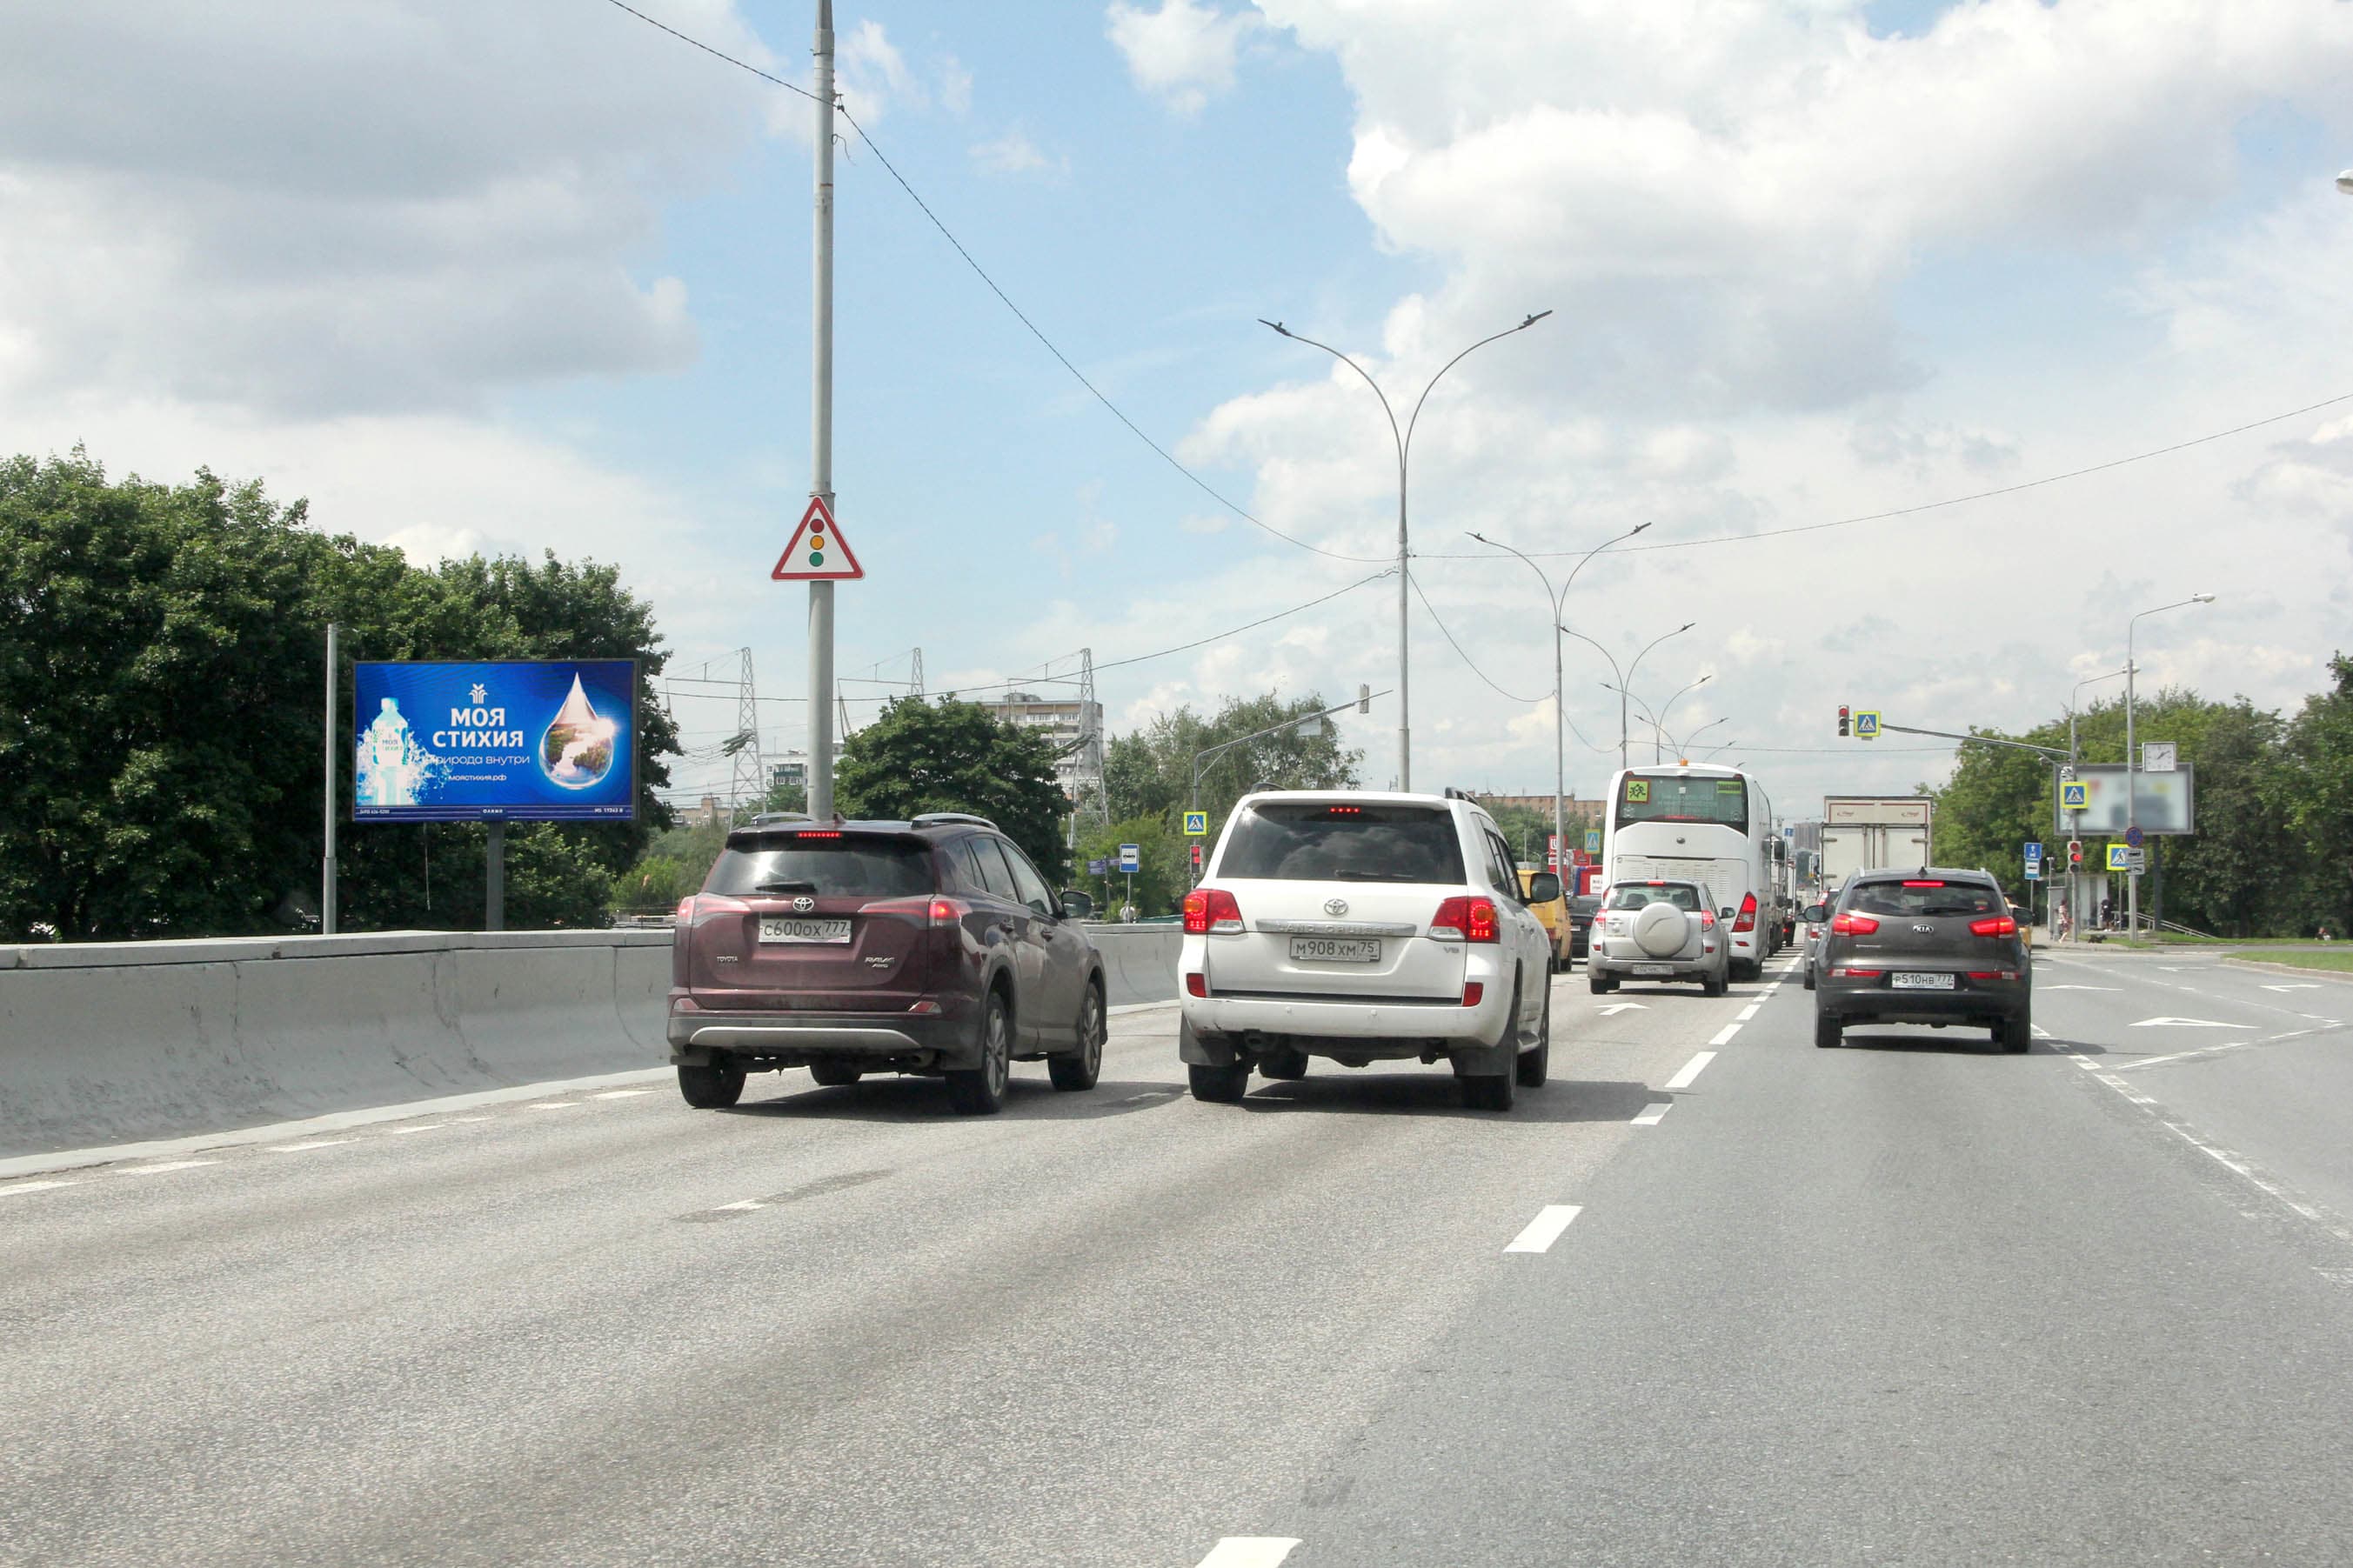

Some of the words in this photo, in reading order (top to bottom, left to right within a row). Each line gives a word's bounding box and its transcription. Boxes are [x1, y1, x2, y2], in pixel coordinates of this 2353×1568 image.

[451, 708, 505, 727] МОЯ
[432, 731, 524, 748] СТИХИЯ
[425, 755, 483, 766] рирода
[485, 755, 531, 766] внутри
[1916, 924, 1930, 933] KIA
